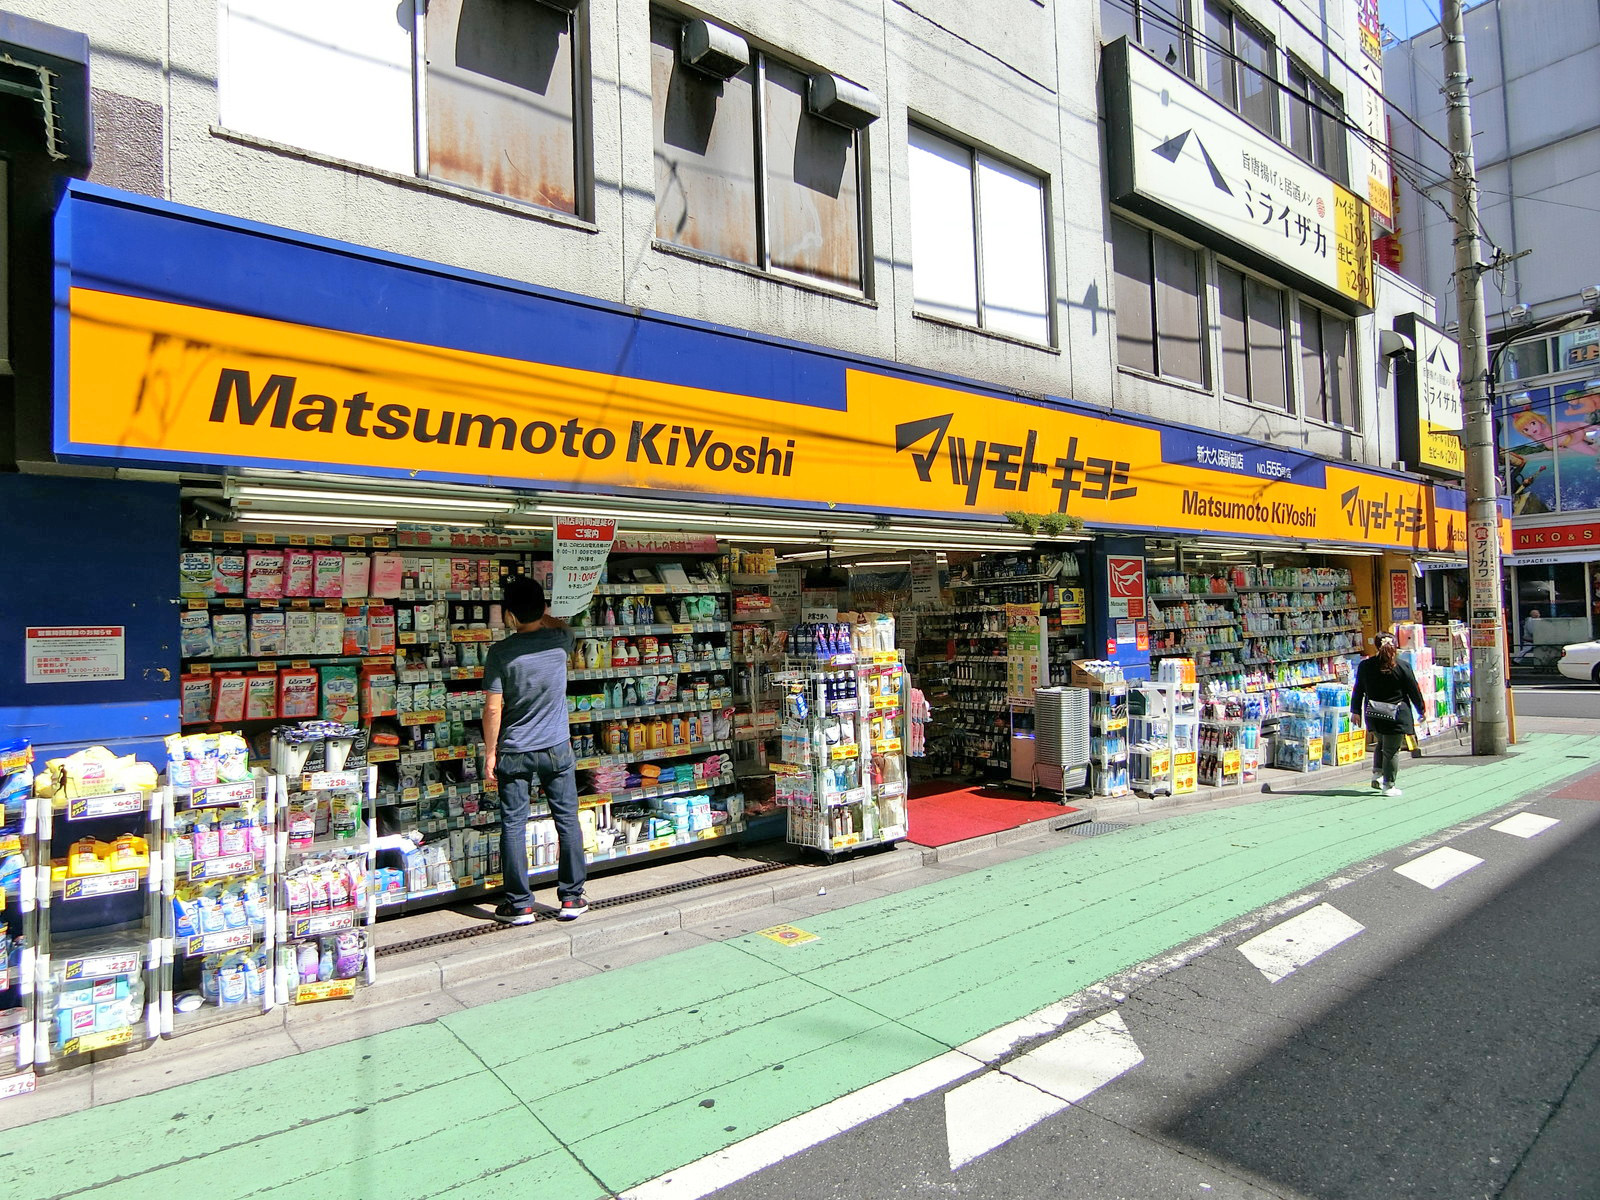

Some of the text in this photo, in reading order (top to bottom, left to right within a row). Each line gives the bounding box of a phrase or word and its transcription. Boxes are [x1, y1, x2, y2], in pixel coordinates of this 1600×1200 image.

[1245, 178, 1327, 259] ミライザカ
[1335, 196, 1366, 226] ハイボール
[1337, 242, 1369, 273] 生ビール
[1424, 382, 1457, 414] ミライザカ
[210, 367, 796, 477] Matsumoto KiYoshi
[896, 413, 1137, 514] マツモトキヨシ
[1196, 445, 1244, 470] 新大久保駅前店
[1181, 489, 1316, 528] Matsumoto KiYoshi
[1340, 485, 1426, 542] マツモトキヨシ
[575, 528, 600, 539] ご案内
[1477, 540, 1489, 577] アイカワ
[306, 758, 325, 766] CARPET
